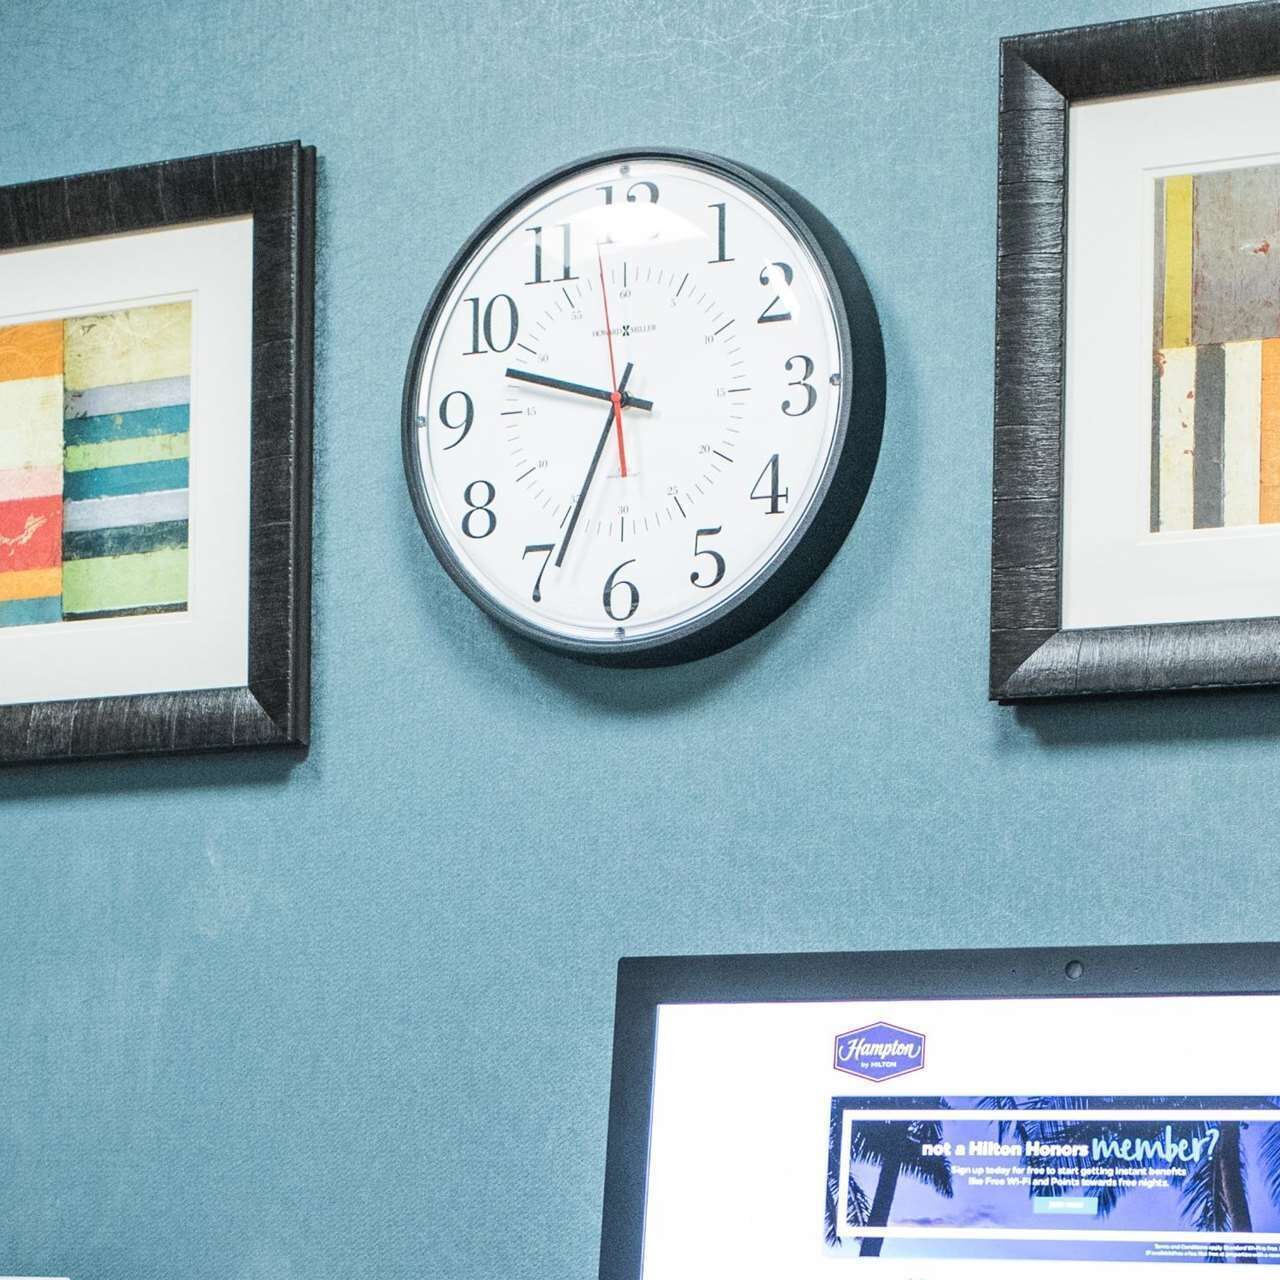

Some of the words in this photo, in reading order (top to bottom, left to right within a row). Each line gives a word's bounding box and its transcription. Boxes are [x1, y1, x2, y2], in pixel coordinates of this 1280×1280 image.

[524, 223, 580, 285] 11
[707, 202, 735, 264] 1
[462, 293, 519, 356] 10
[757, 262, 796, 325] 2
[781, 355, 818, 417] 3
[438, 391, 475, 450] 9
[461, 480, 497, 539] 8
[750, 454, 789, 515] 4
[522, 543, 556, 603] 7
[690, 525, 727, 588] 5
[603, 559, 640, 621] 6
[839, 1038, 921, 1061] Hampton
[922, 1141, 951, 1156] not
[955, 1144, 965, 1156] a
[969, 1140, 1022, 1157] Hilton
[1025, 1141, 1089, 1157] Honors
[1092, 1125, 1220, 1163] member?
